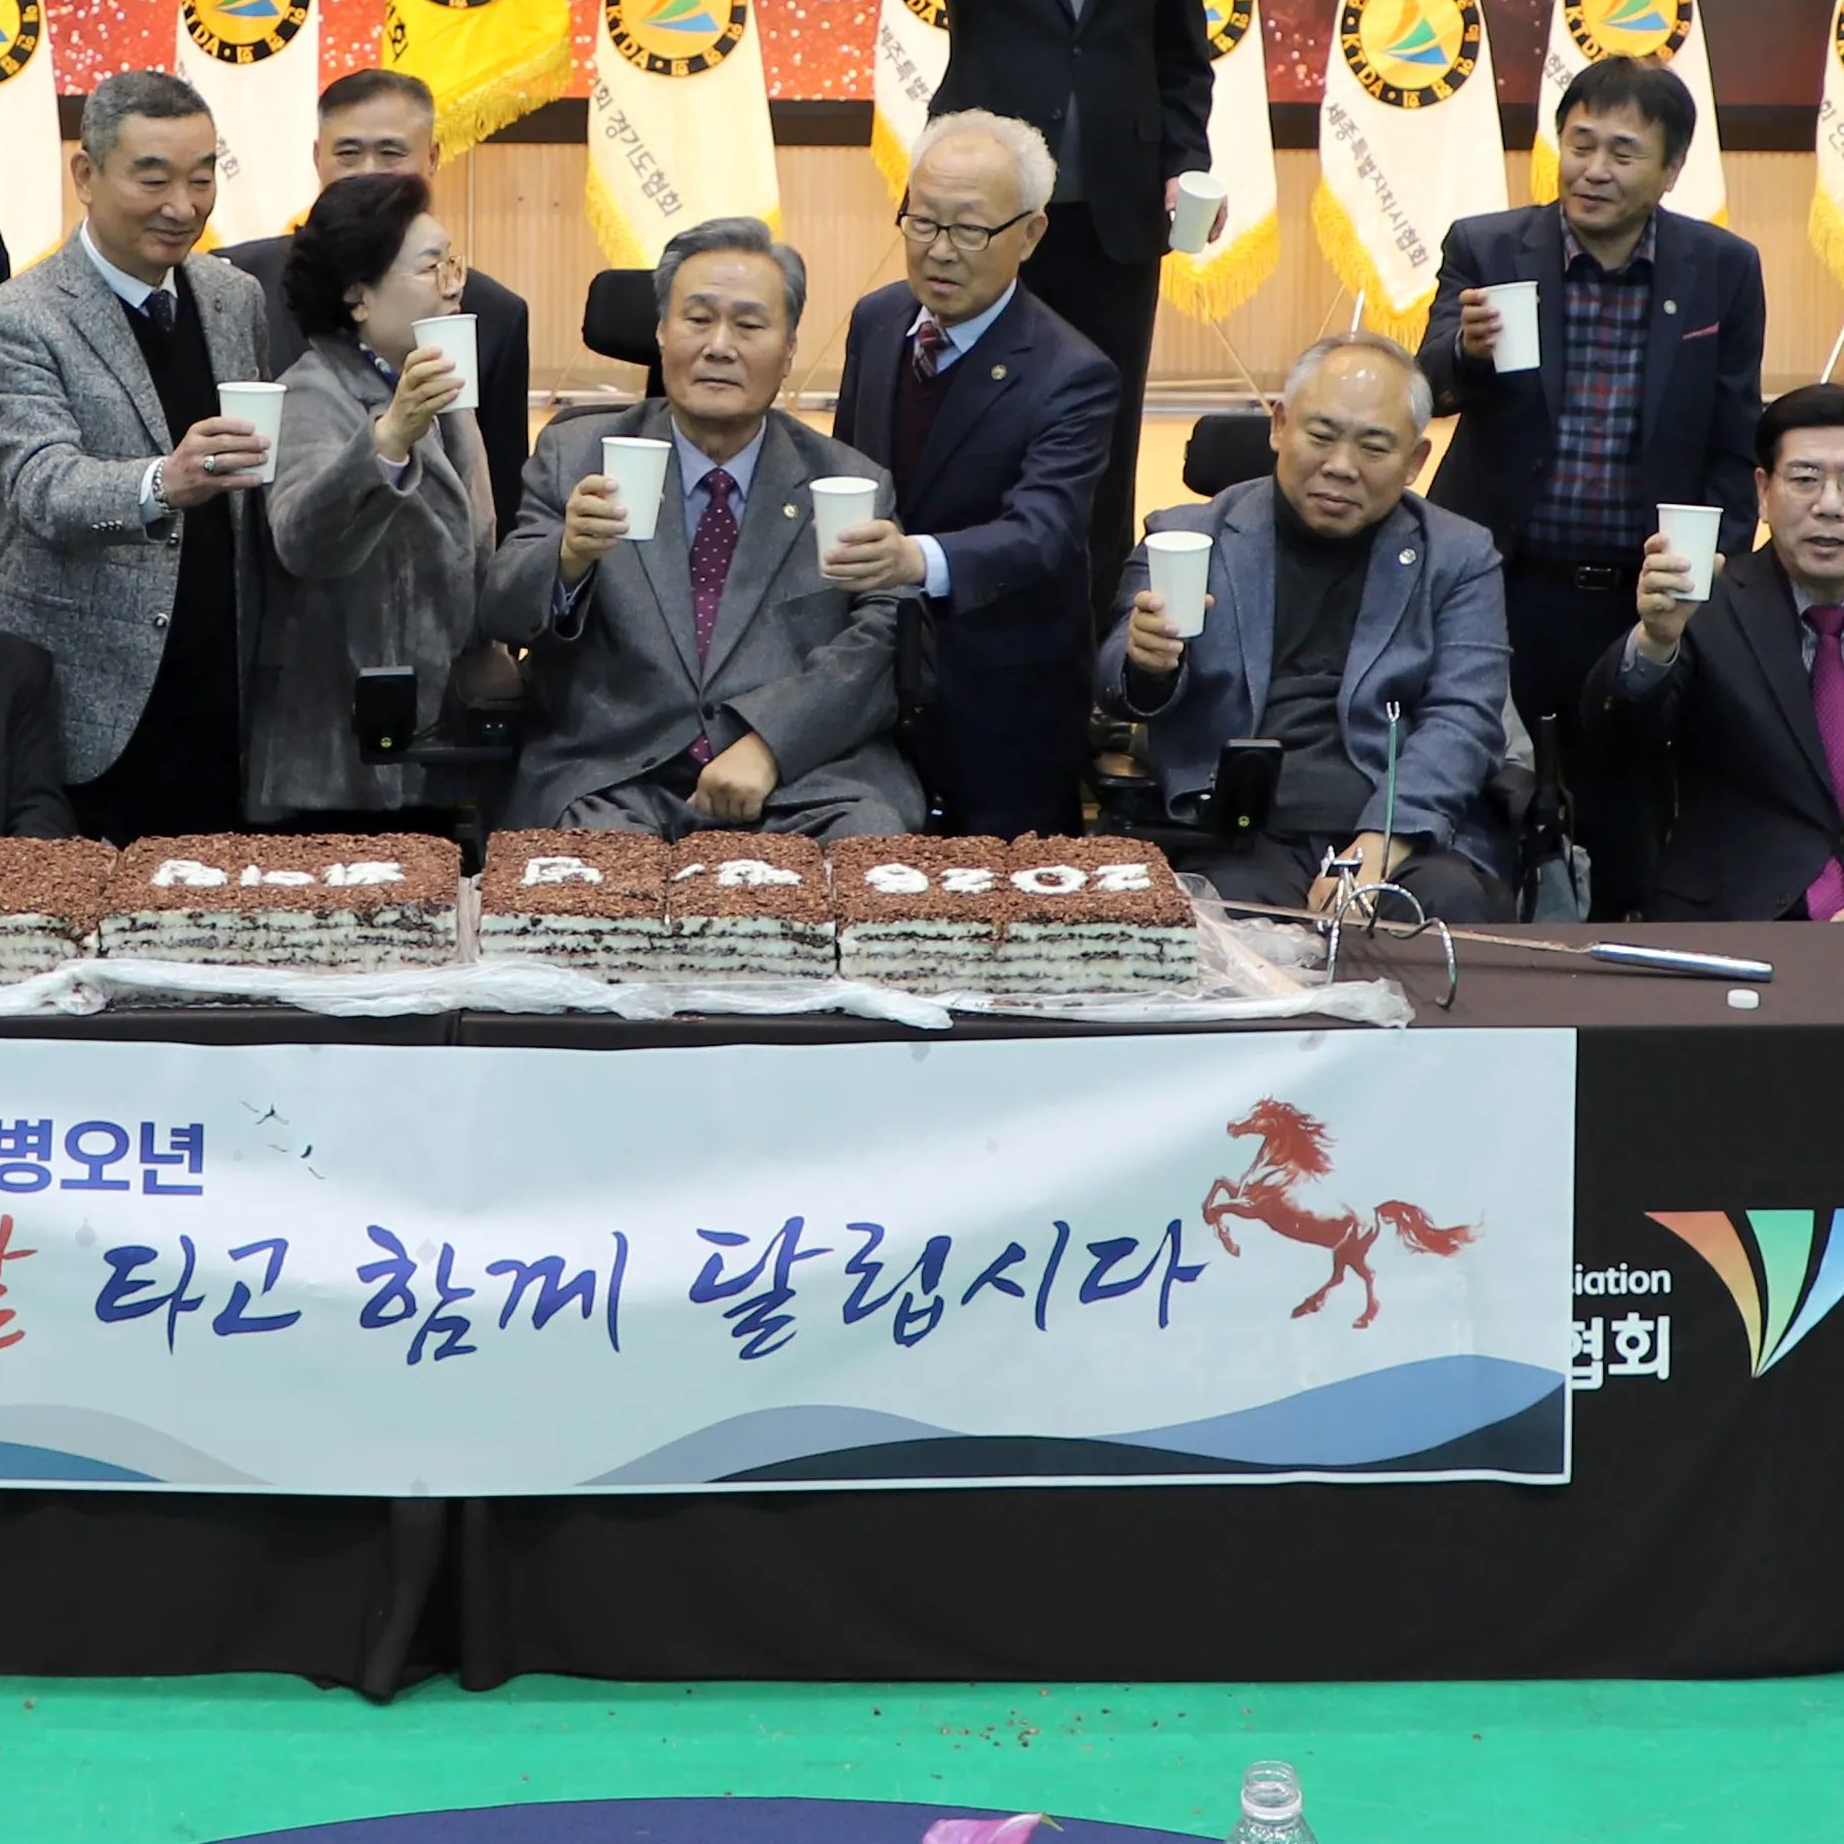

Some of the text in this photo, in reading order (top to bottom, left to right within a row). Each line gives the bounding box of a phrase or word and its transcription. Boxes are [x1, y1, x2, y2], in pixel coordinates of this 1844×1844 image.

[605, 5, 652, 71] KTDA
[1341, 33, 1385, 97] KTDA
[604, 107, 684, 220] 경기도협회
[1324, 100, 1430, 269] 세종특별자치시협회
[94, 1232, 304, 1356] 타고
[355, 1223, 630, 1367] 함께
[687, 1214, 1212, 1362] 달립시다
